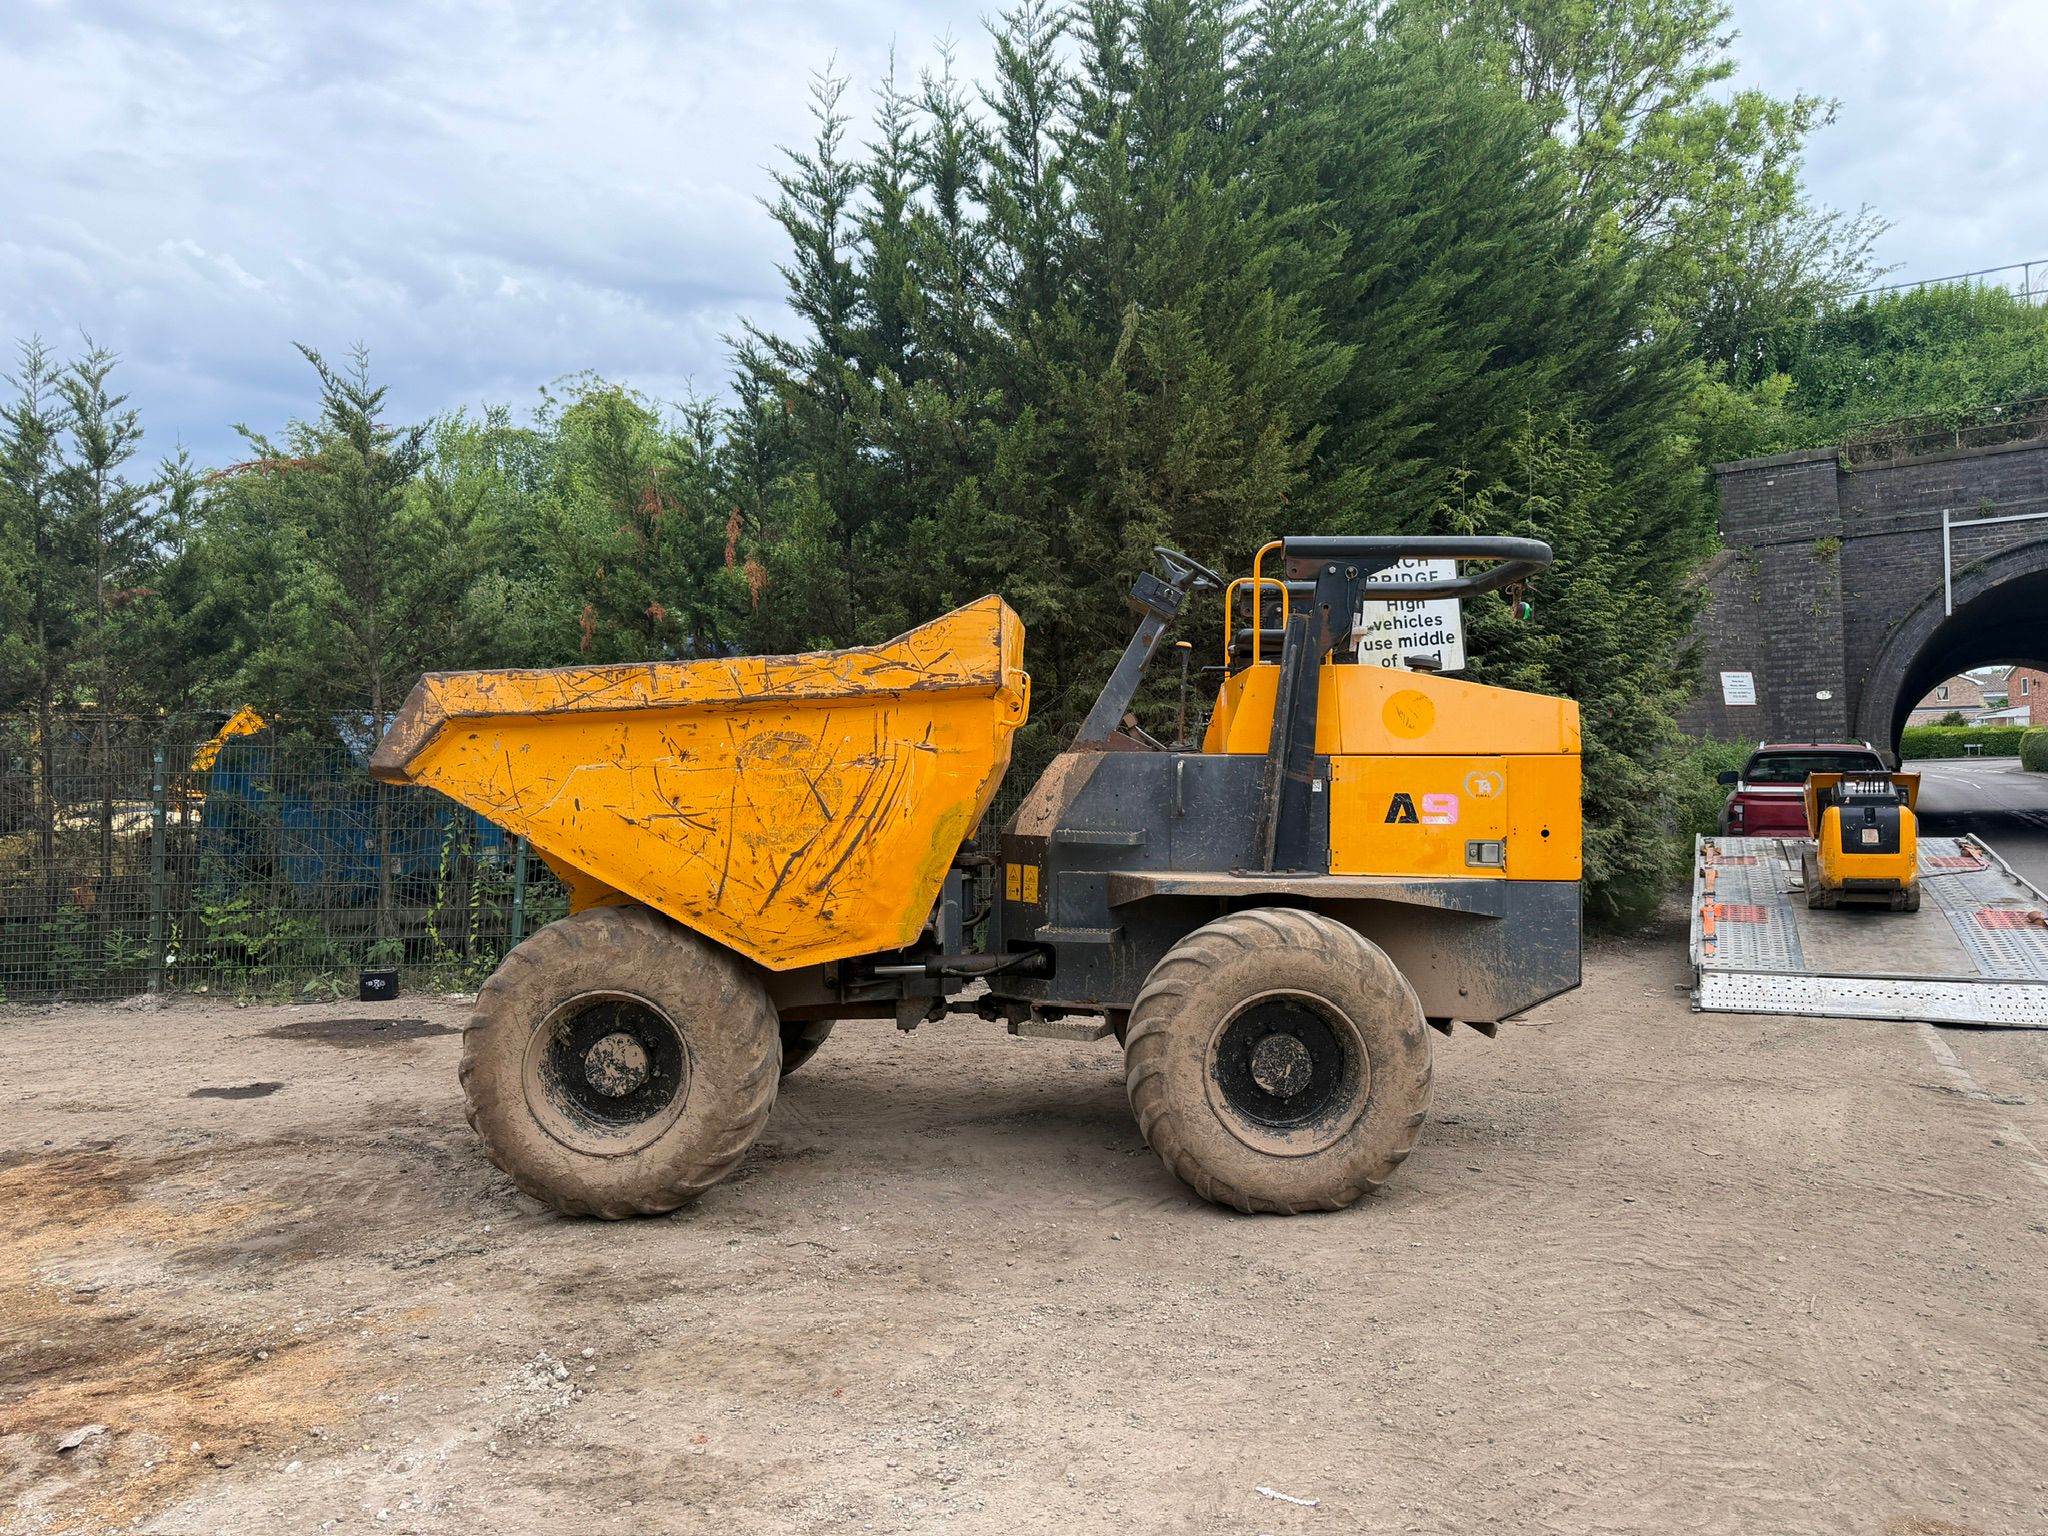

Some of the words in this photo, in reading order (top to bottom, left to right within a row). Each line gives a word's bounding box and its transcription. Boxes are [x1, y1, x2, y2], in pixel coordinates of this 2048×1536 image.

[1386, 600, 1426, 613] High
[1373, 614, 1443, 631] vehicles
[1364, 639, 1393, 651] use
[1398, 631, 1455, 648] middle
[1381, 654, 1398, 668] of
